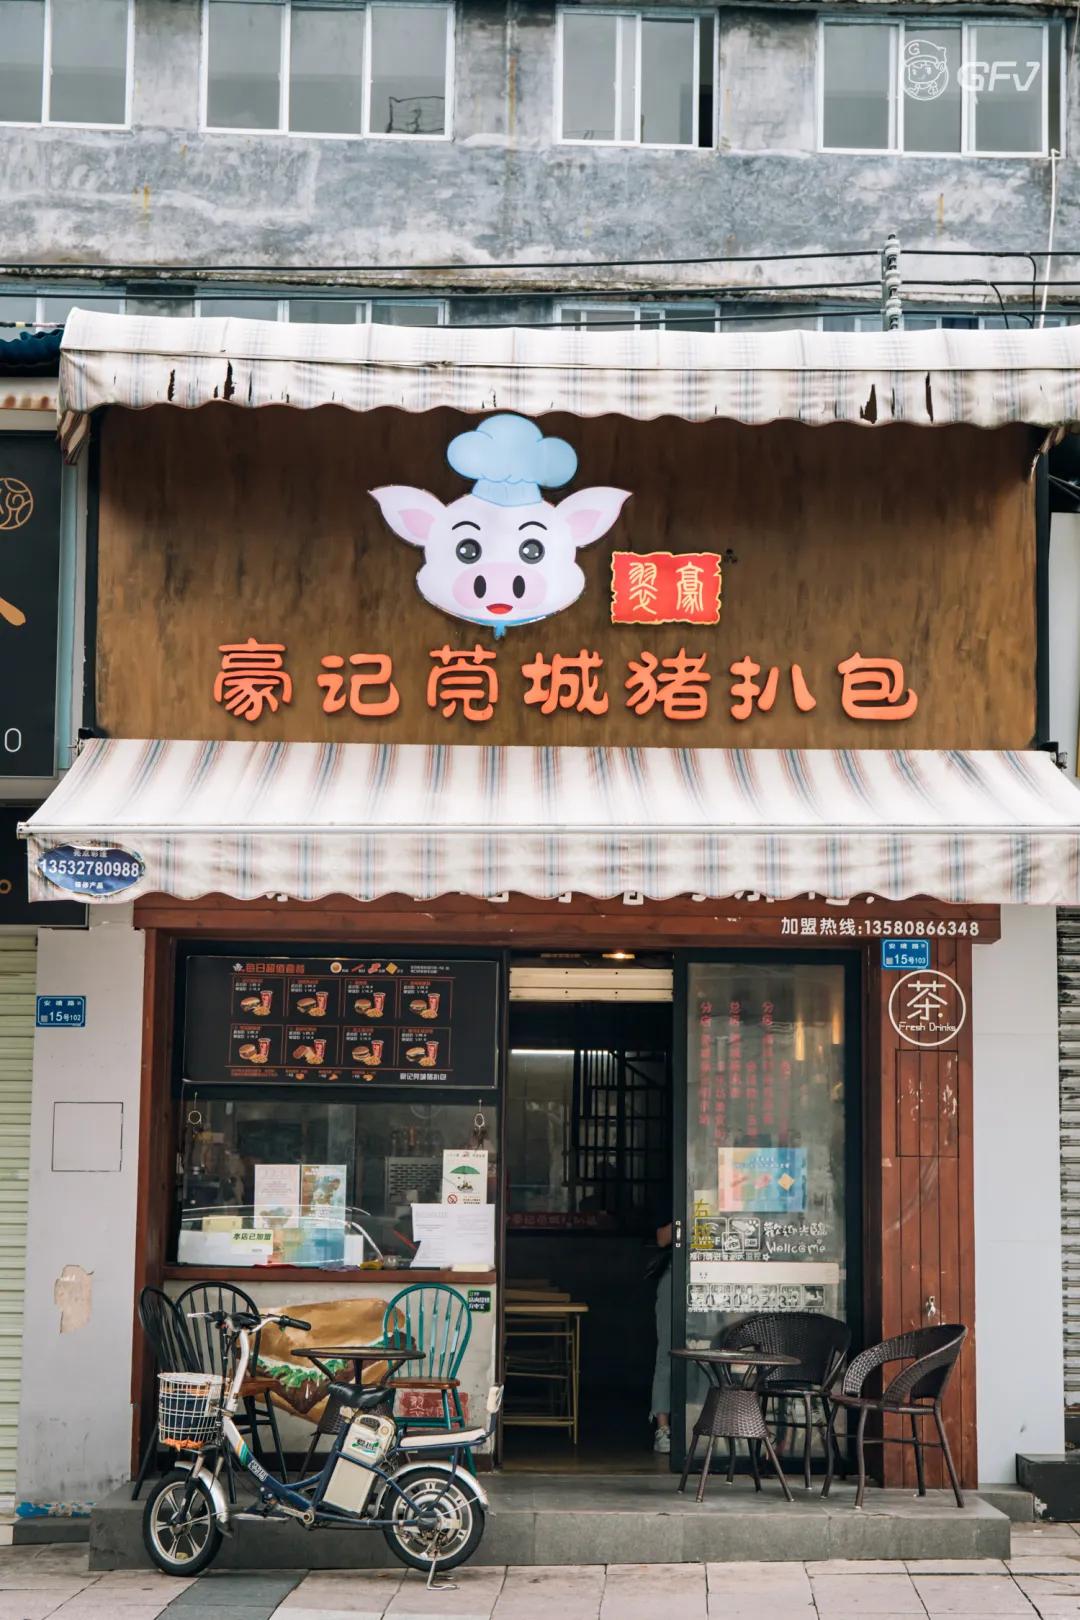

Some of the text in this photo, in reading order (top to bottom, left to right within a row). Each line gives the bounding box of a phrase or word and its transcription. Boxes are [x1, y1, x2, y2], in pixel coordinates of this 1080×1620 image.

[213, 637, 918, 721] 豪记莞城猪扒包
[40, 859, 139, 877] 13532780988
[906, 980, 948, 1021] 茶
[899, 1021, 956, 1032] Fresh Drinks
